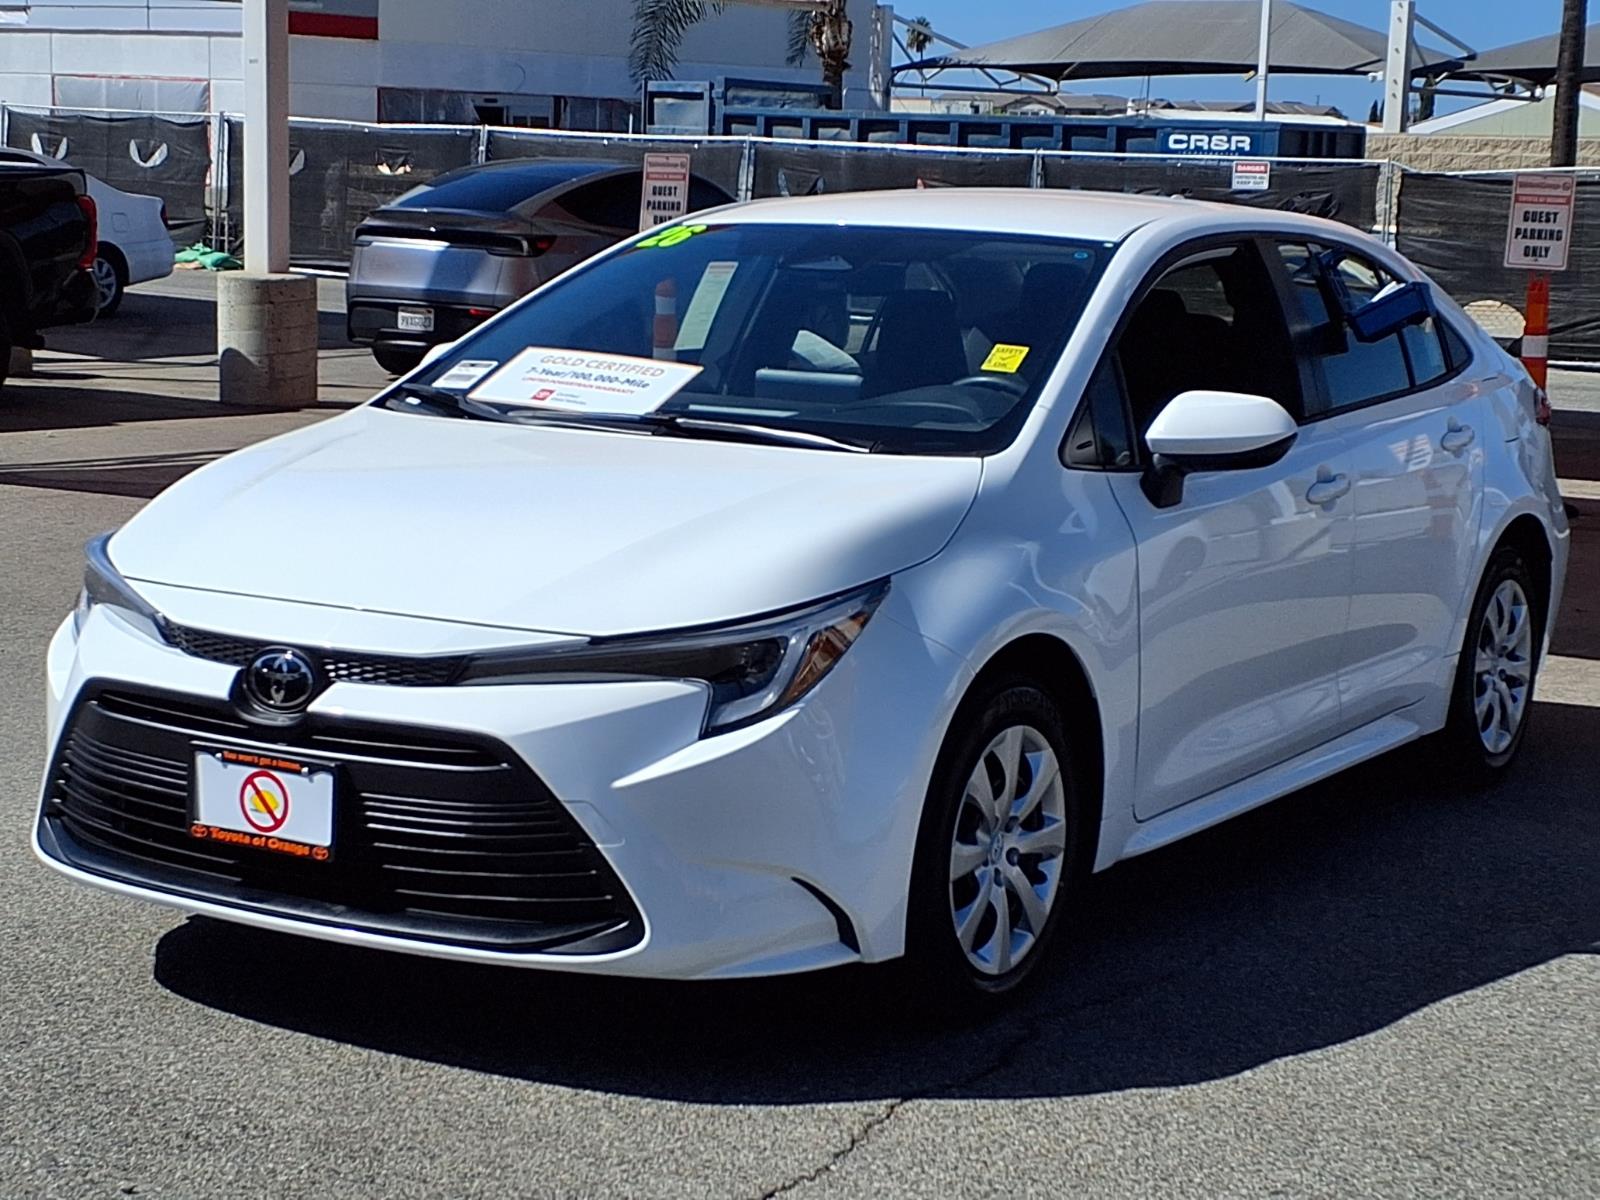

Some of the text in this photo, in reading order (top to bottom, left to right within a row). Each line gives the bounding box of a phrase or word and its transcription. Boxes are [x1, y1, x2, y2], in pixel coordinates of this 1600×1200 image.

[1168, 133, 1251, 151] CR&R
[646, 200, 681, 212] PARKING
[1523, 210, 1559, 224] GUEST
[1514, 227, 1563, 242] PARKING
[1523, 245, 1551, 258] ONLY
[540, 355, 665, 377] GOLD CERTIFIED
[525, 366, 650, 389] 7-Year/100,000-Mile
[209, 827, 310, 856] Toyota of Orange
